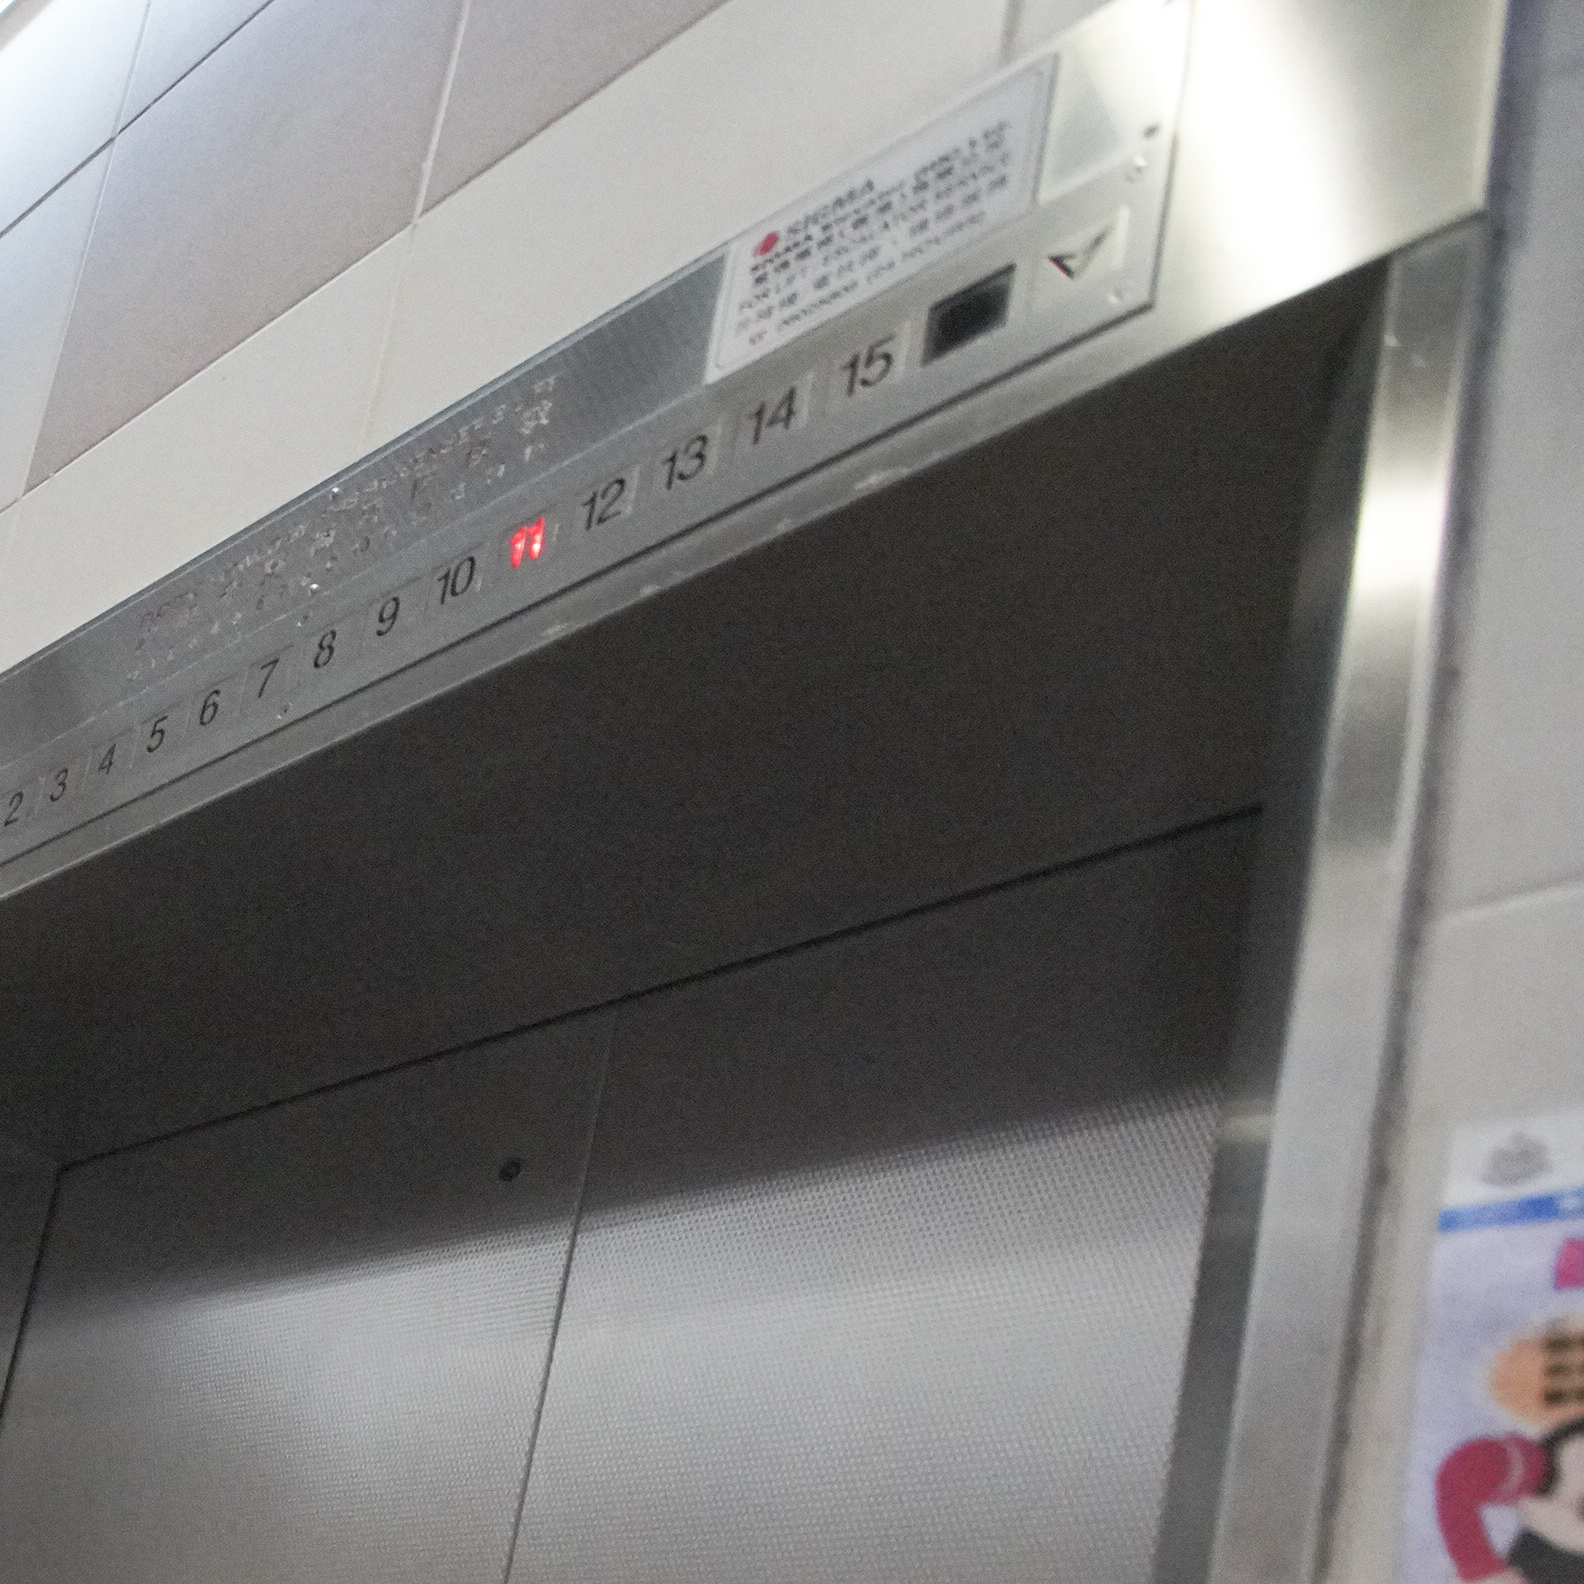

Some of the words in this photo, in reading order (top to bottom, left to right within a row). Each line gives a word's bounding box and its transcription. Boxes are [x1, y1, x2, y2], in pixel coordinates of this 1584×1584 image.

[4, 791, 24, 827] 2
[49, 768, 69, 802] 3
[98, 743, 117, 774] 4
[146, 715, 168, 753] 5
[199, 689, 221, 726] 6
[258, 657, 280, 698] 7
[314, 629, 337, 669] 8
[376, 597, 400, 636] 9
[437, 556, 476, 604] 10
[509, 517, 546, 568] 11
[581, 478, 626, 530] 12
[660, 434, 708, 490] 13
[748, 387, 798, 444] 14
[840, 336, 895, 397] 15
